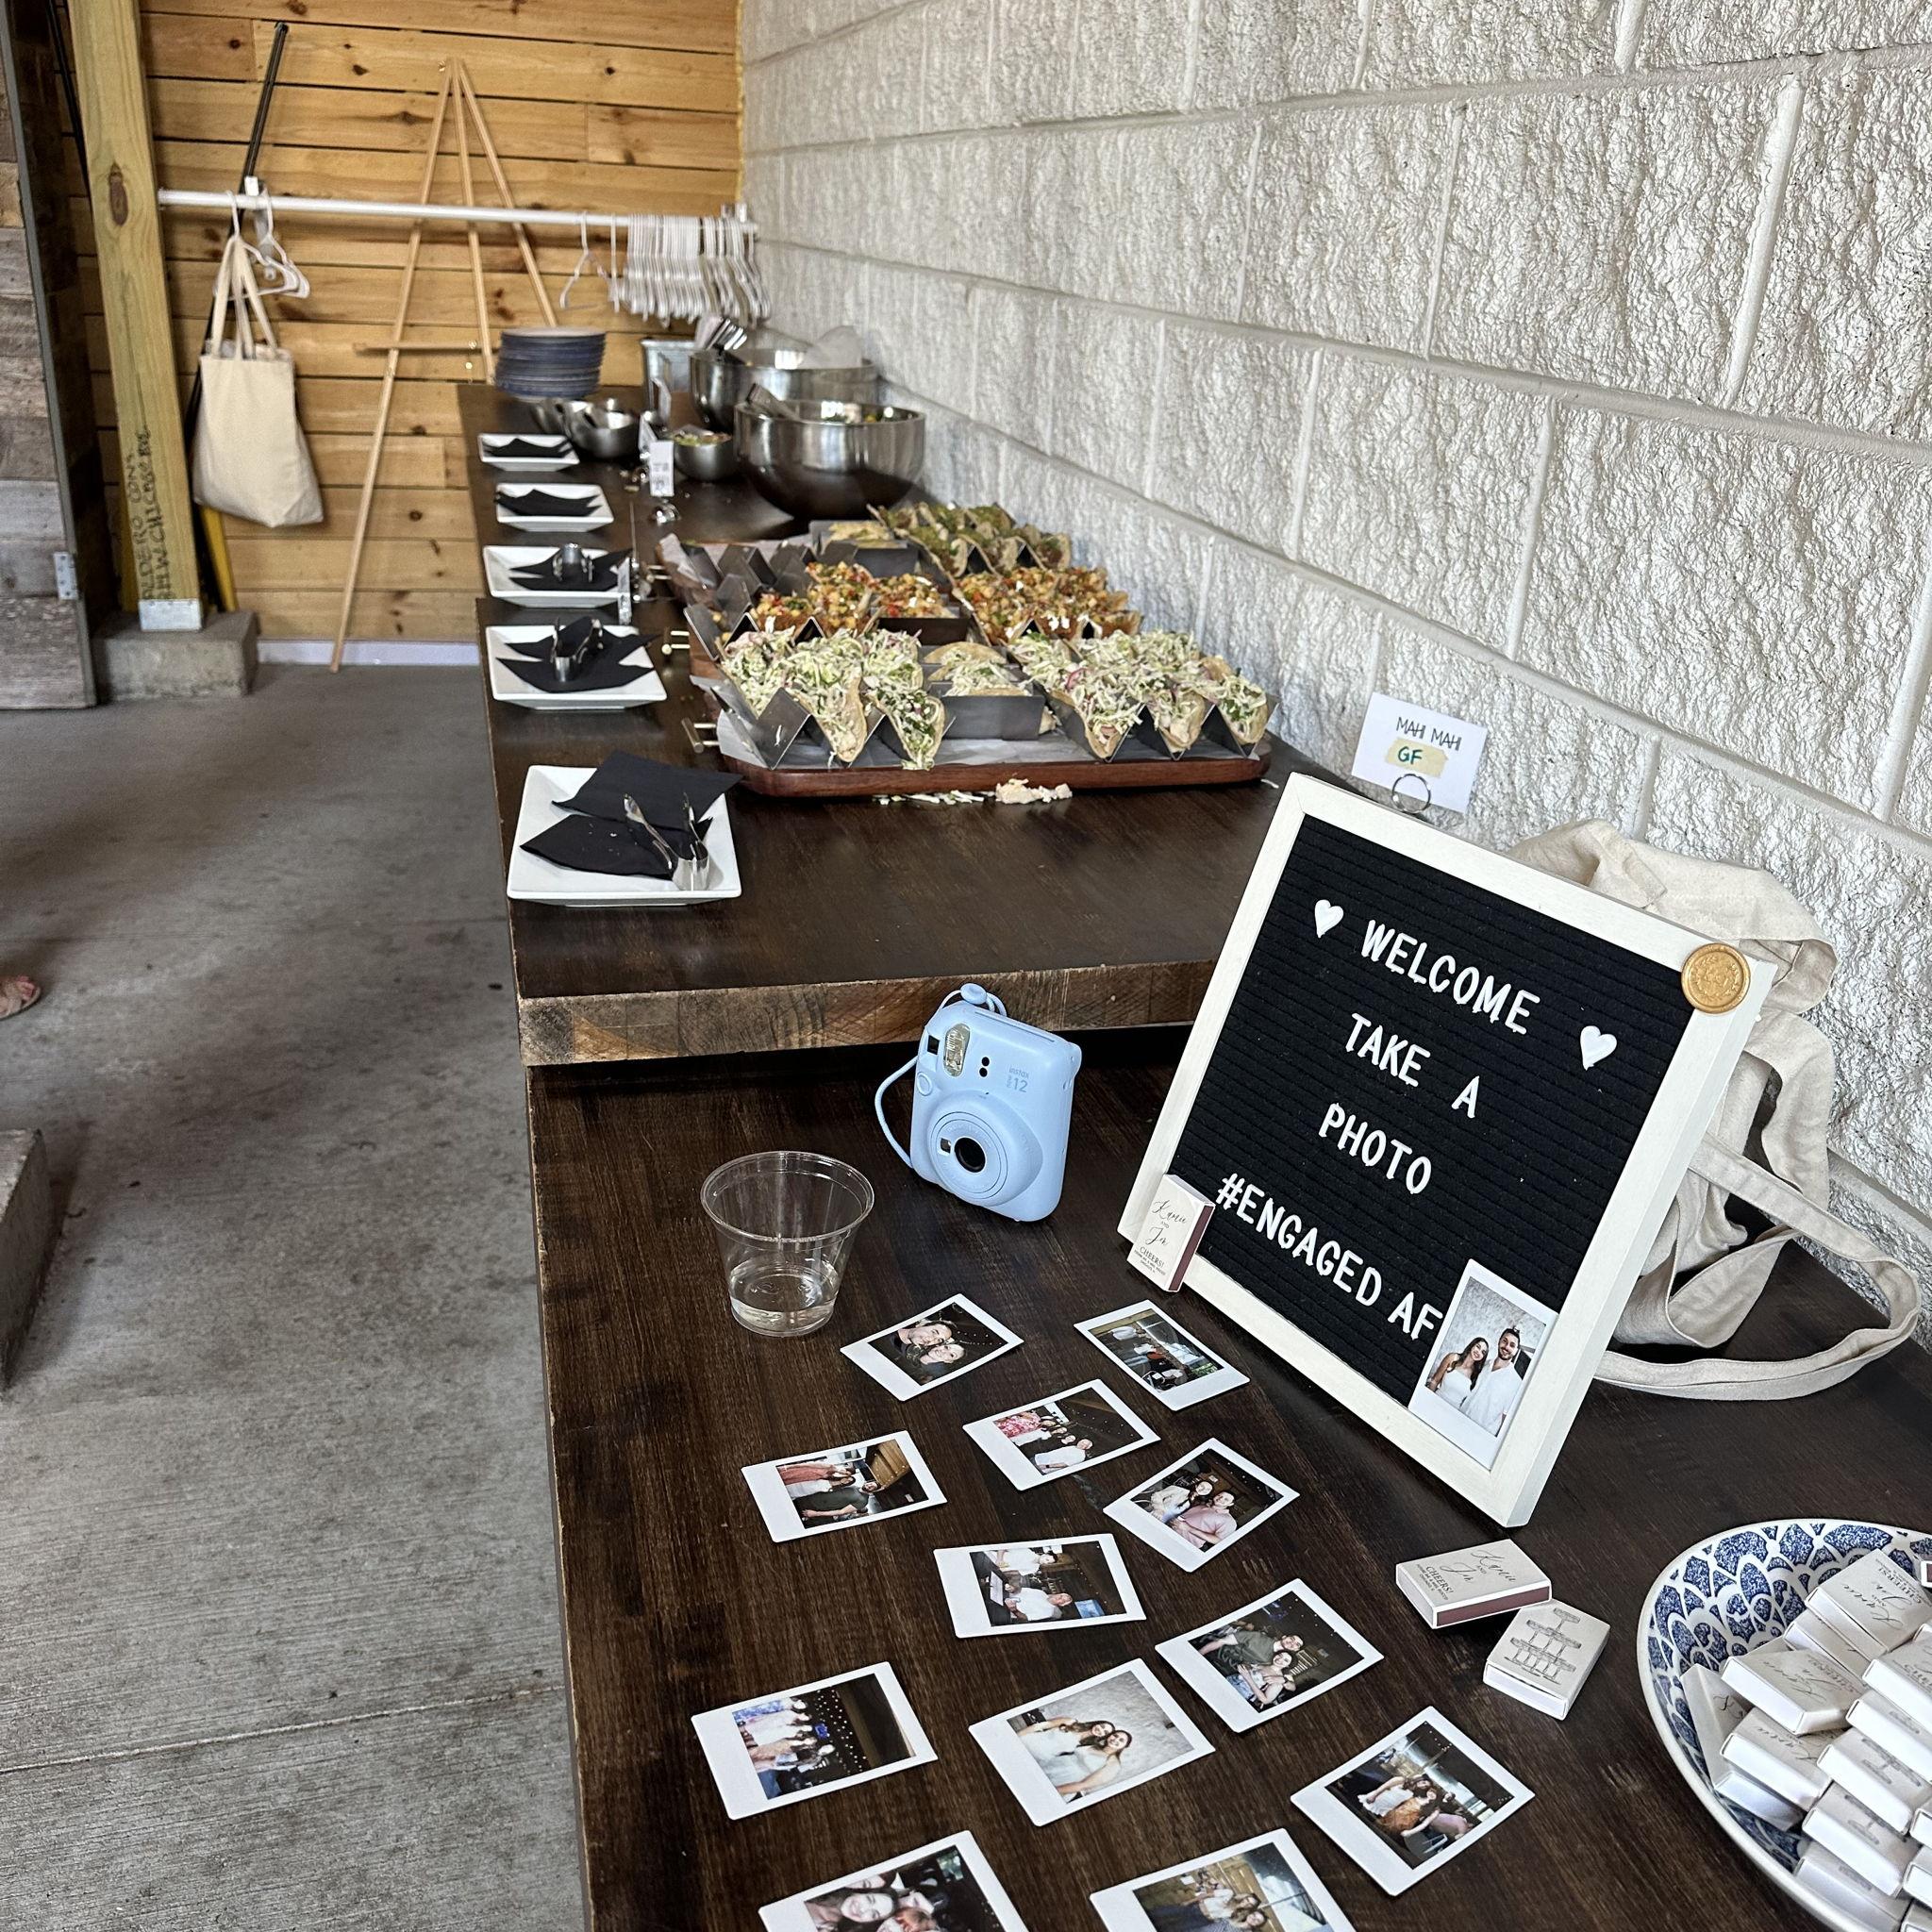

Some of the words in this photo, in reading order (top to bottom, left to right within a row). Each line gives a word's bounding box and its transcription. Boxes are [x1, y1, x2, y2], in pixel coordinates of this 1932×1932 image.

[1398, 745, 1424, 765] GF
[1361, 920, 1540, 1035] WELCOME
[1013, 1077, 1028, 1093] 12
[1345, 1012, 1430, 1087] TAKE
[1451, 1075, 1480, 1119] A
[1318, 1102, 1432, 1195] PHOTO
[1140, 1246, 1165, 1268] CHEERS!
[1215, 1173, 1382, 1307] #ENGAGED
[1388, 1291, 1443, 1341] AF
[1426, 1566, 1454, 1593] CHEERS!
